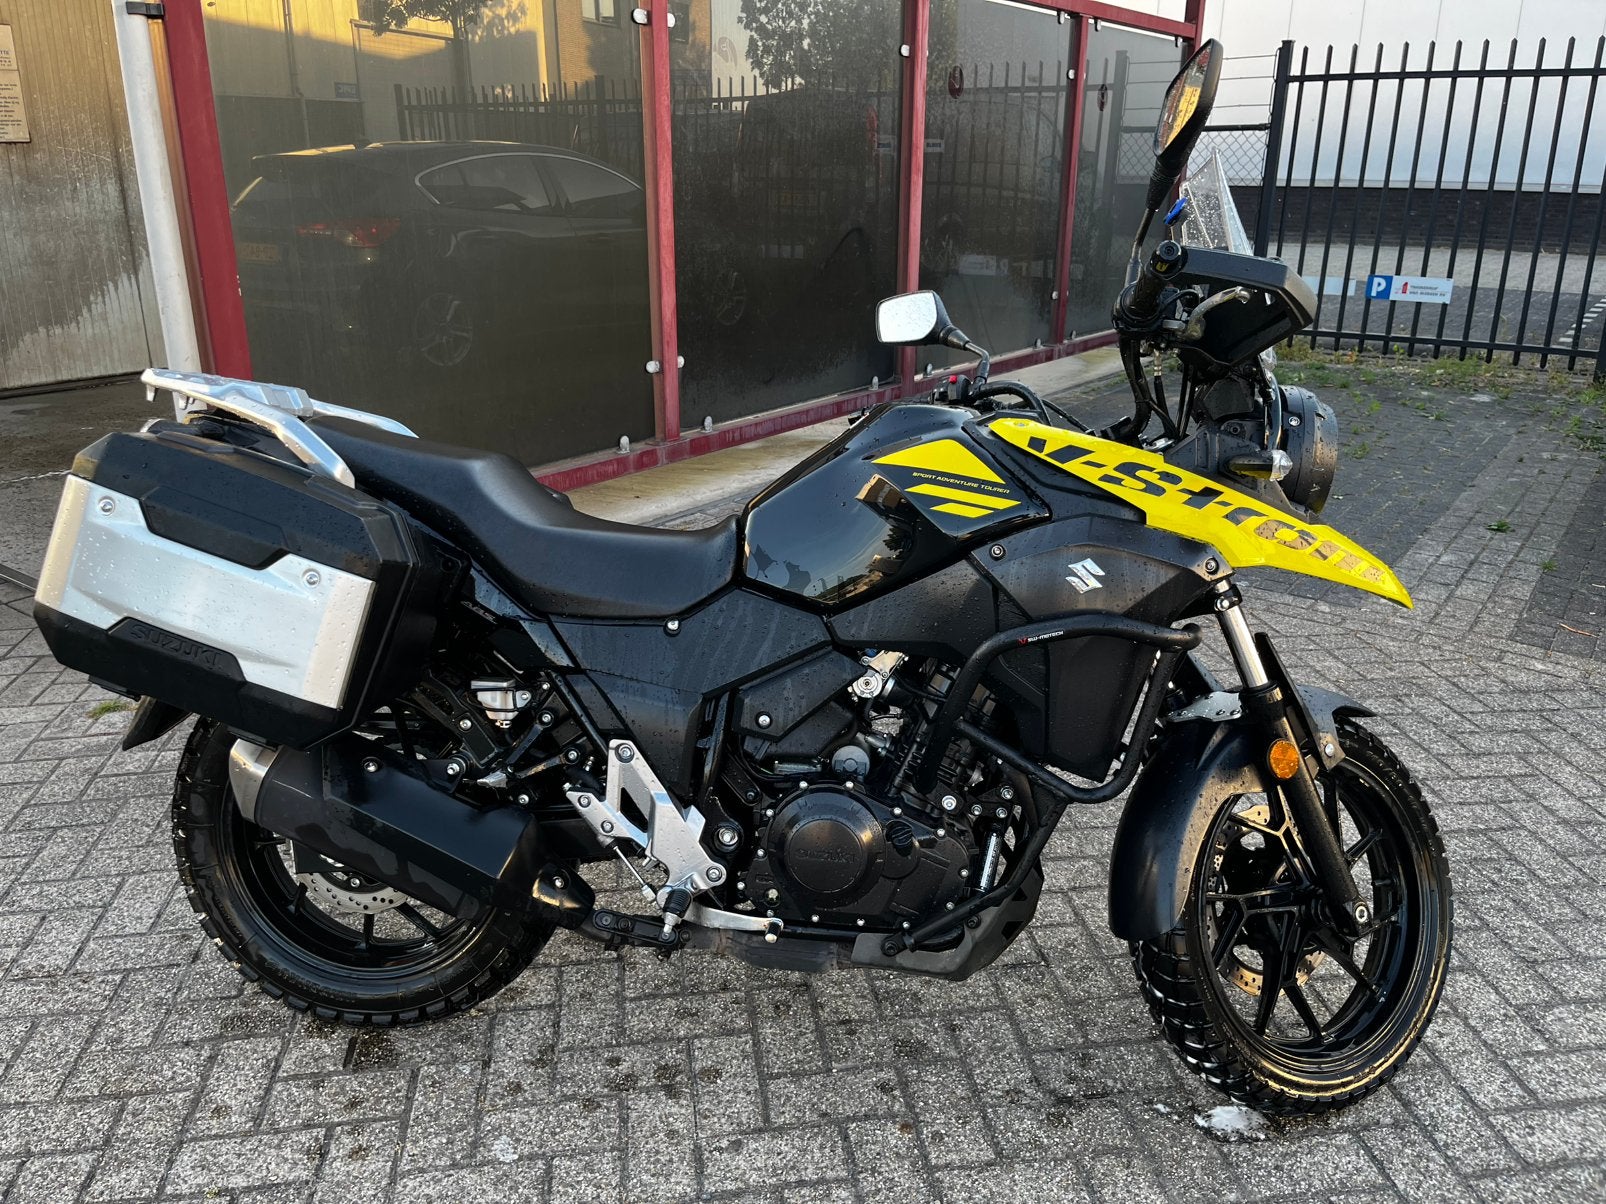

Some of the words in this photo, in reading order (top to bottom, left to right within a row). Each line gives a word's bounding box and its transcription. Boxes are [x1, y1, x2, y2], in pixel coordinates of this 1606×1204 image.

[1371, 277, 1387, 297] P
[912, 471, 936, 480] SPORT
[936, 476, 979, 488] ADVENTURE
[981, 484, 1010, 494] TOURER
[130, 624, 223, 666] SUZUKI
